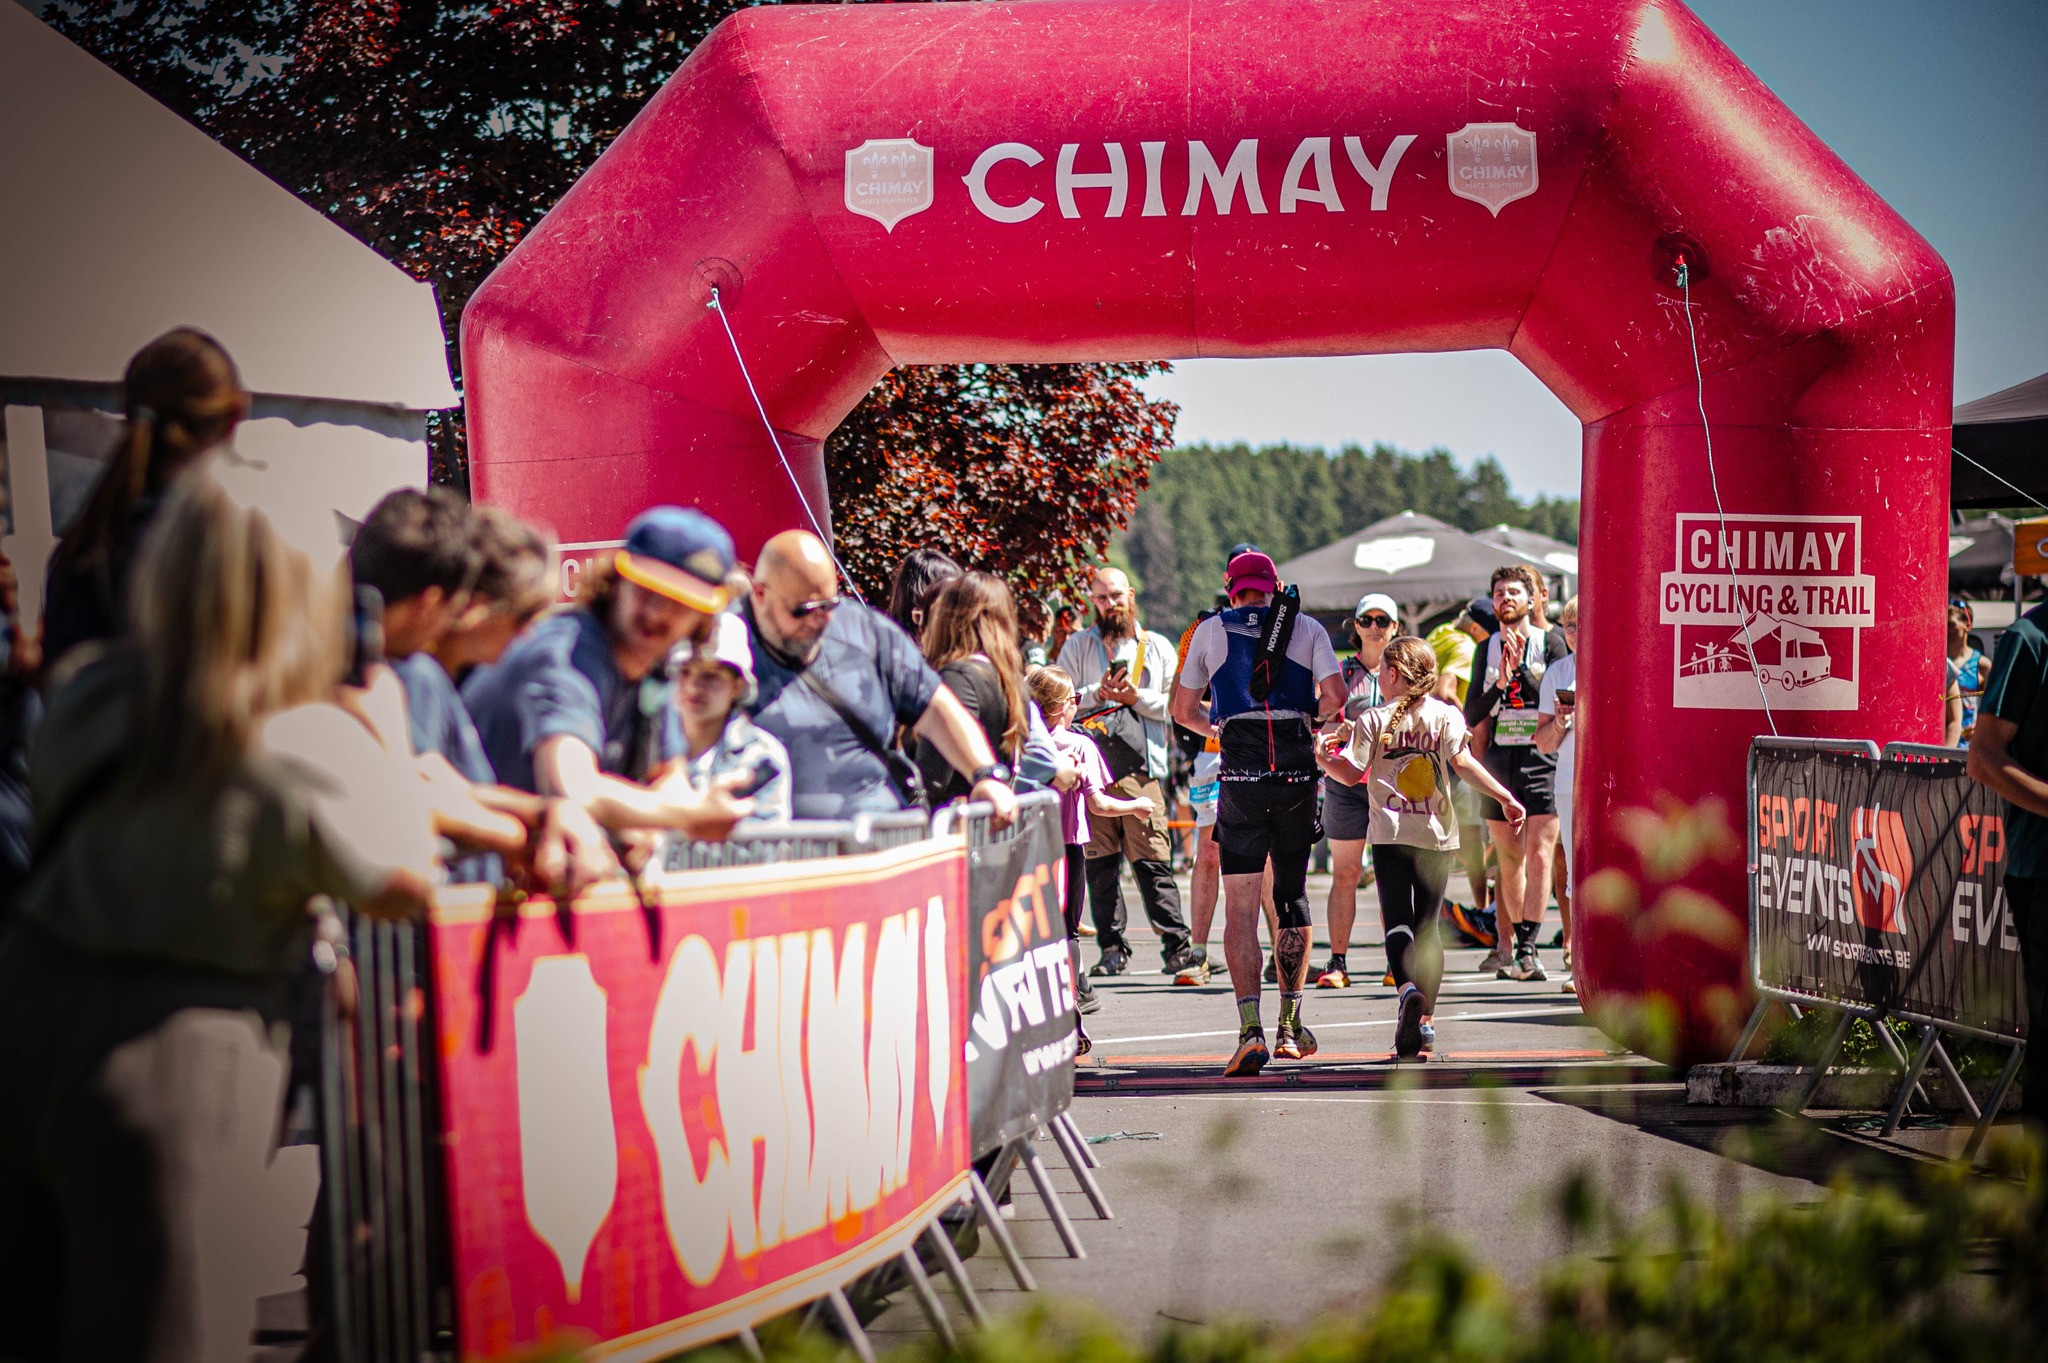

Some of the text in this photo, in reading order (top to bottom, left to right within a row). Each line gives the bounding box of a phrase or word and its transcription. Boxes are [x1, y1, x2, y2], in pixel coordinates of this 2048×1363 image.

[855, 180, 925, 196] CHIMAY
[961, 134, 1418, 224] CHIMAY
[1460, 165, 1529, 180] CHIMAY
[1690, 528, 1847, 571] CHIMAY
[1267, 604, 1287, 652] SALOMON
[1759, 795, 1838, 858] SPORT
[1958, 814, 2008, 876] SP
[1759, 853, 1854, 924] EVENTS
